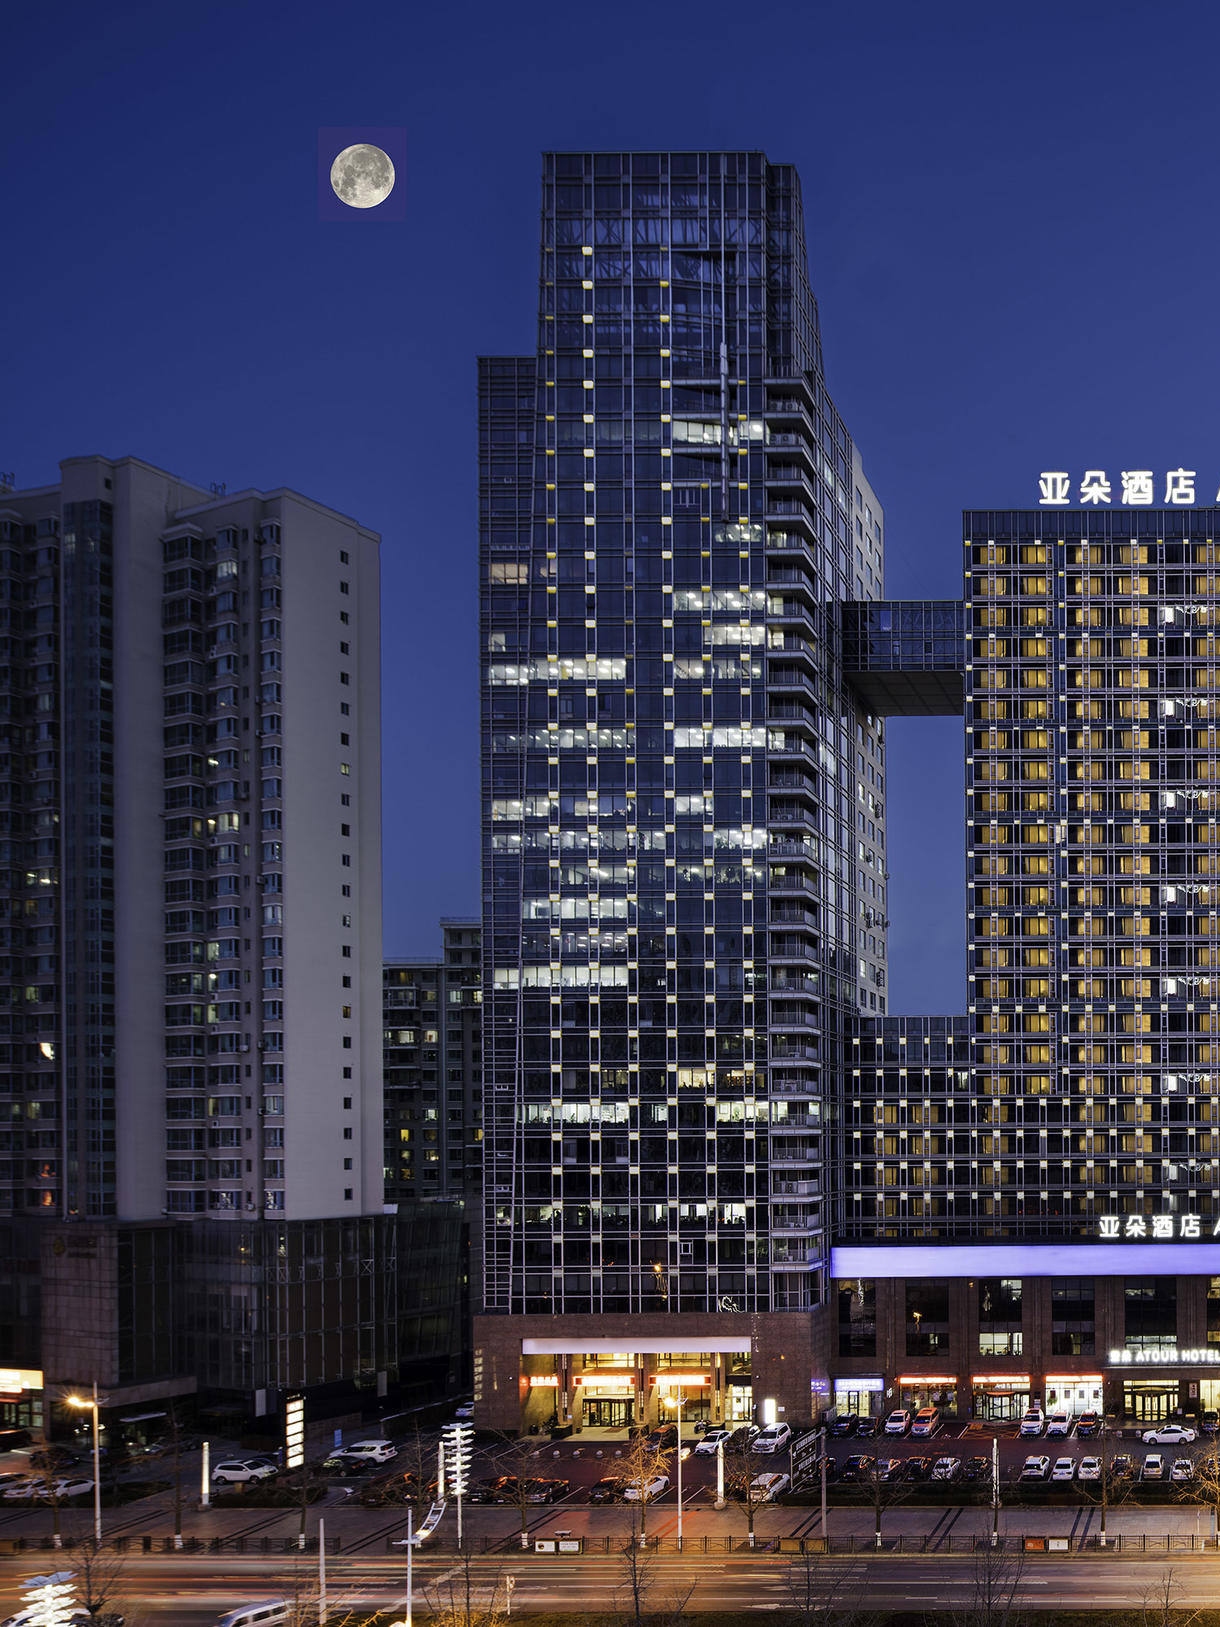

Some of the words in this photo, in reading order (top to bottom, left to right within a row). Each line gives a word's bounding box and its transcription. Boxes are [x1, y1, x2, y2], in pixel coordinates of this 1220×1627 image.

[1038, 468, 1197, 505] 亚朵酒店
[1099, 1213, 1201, 1238] 亚朵酒店
[1135, 1350, 1178, 1362] ATOUR
